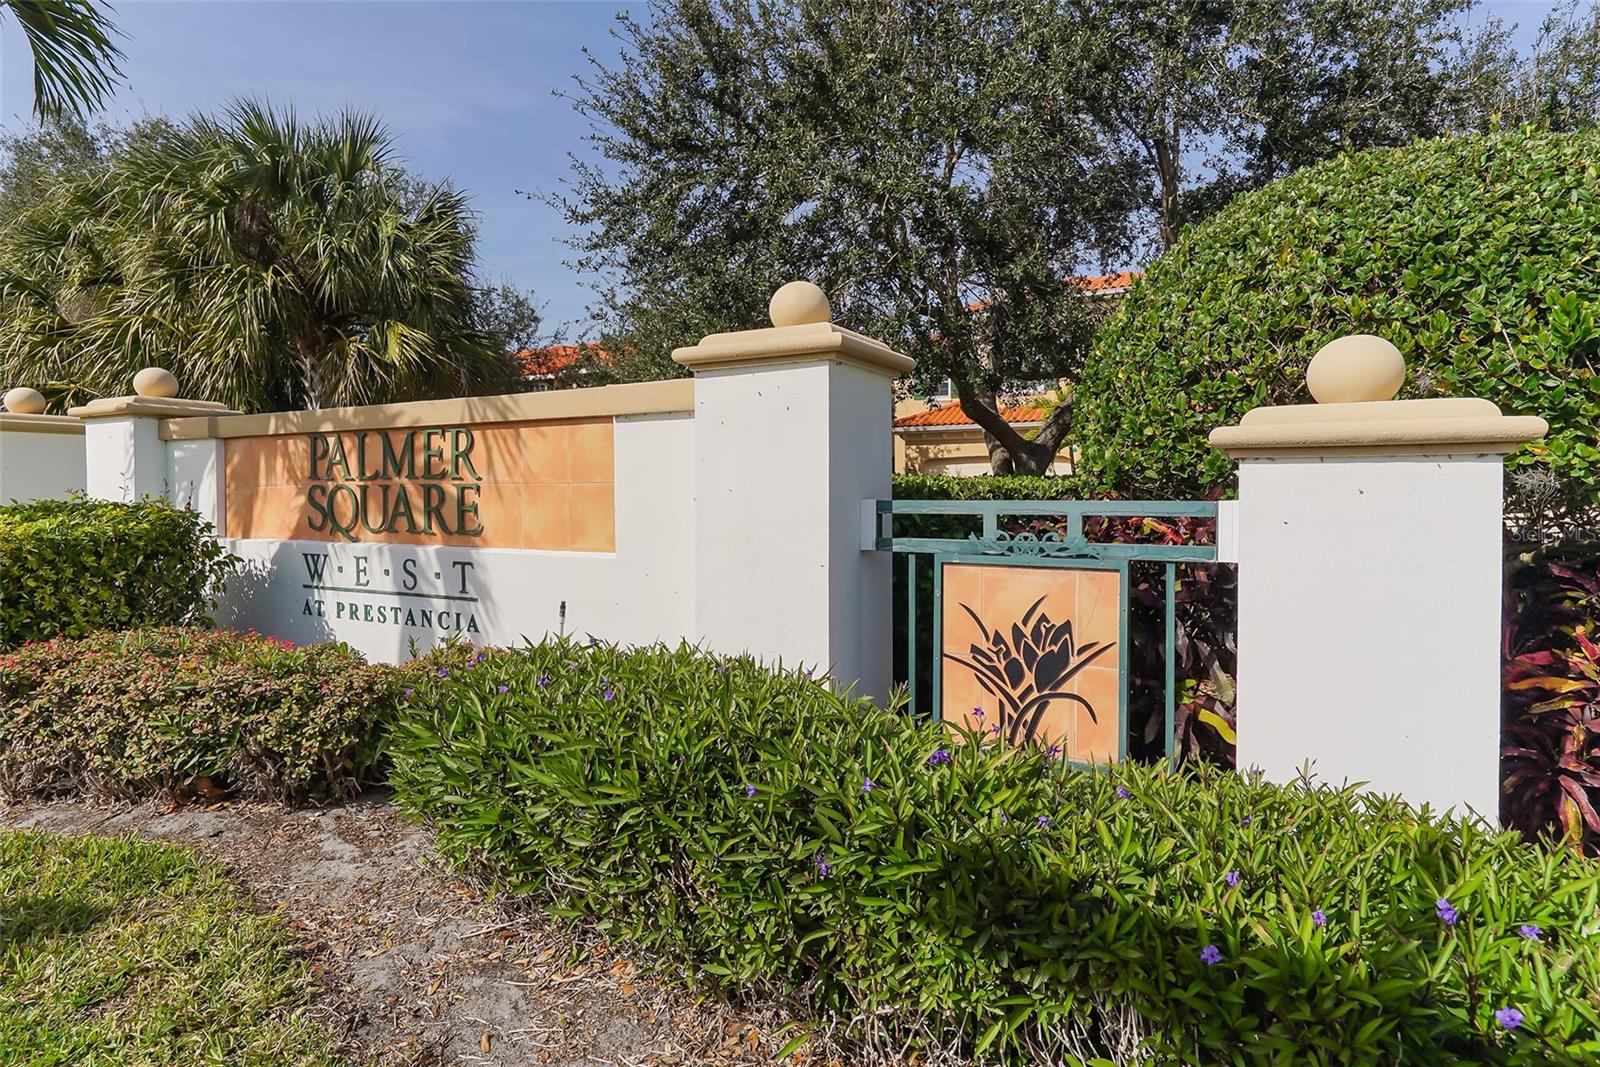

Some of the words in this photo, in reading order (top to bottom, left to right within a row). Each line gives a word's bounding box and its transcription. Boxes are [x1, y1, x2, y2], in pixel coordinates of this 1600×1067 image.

[308, 426, 482, 482] PALMER
[307, 483, 484, 542] SQUARE
[302, 600, 325, 617] AT
[336, 601, 480, 633] PRESTANCIA
